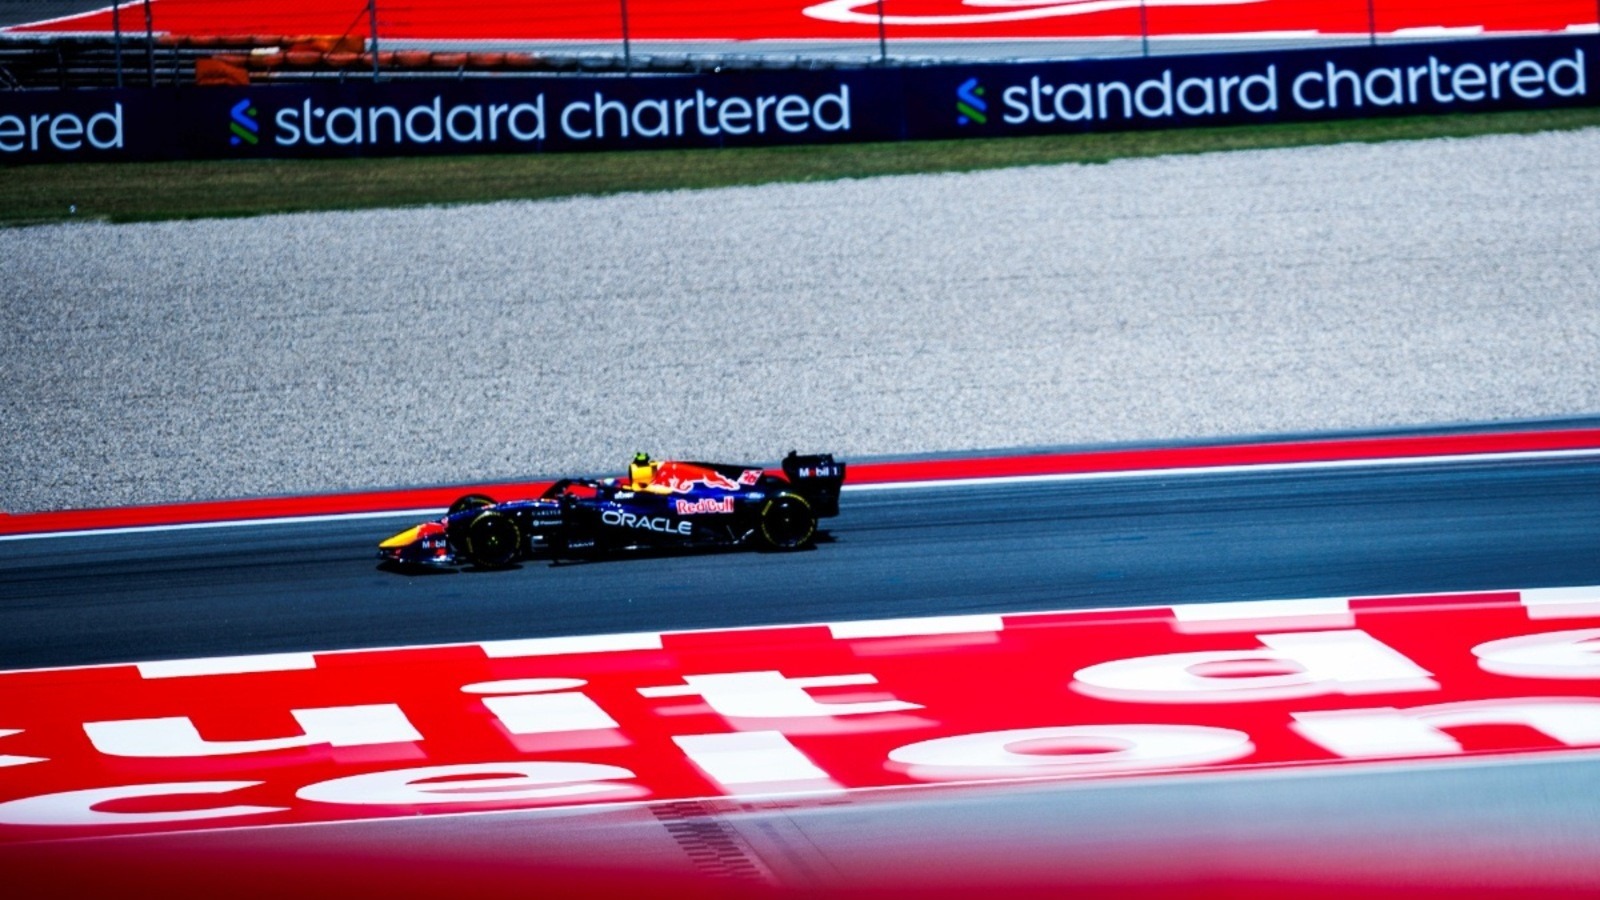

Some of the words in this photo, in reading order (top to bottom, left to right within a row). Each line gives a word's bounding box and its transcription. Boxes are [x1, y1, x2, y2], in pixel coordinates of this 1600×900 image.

[1002, 65, 1278, 124] standard
[1291, 49, 1587, 111] chartered
[0, 102, 124, 152] ered
[275, 94, 546, 146] standard
[560, 84, 850, 139] chartered
[799, 467, 829, 477] Mobil
[422, 539, 447, 549] Mobil
[601, 510, 693, 535] ORACLE
[0, 670, 926, 768] uit
